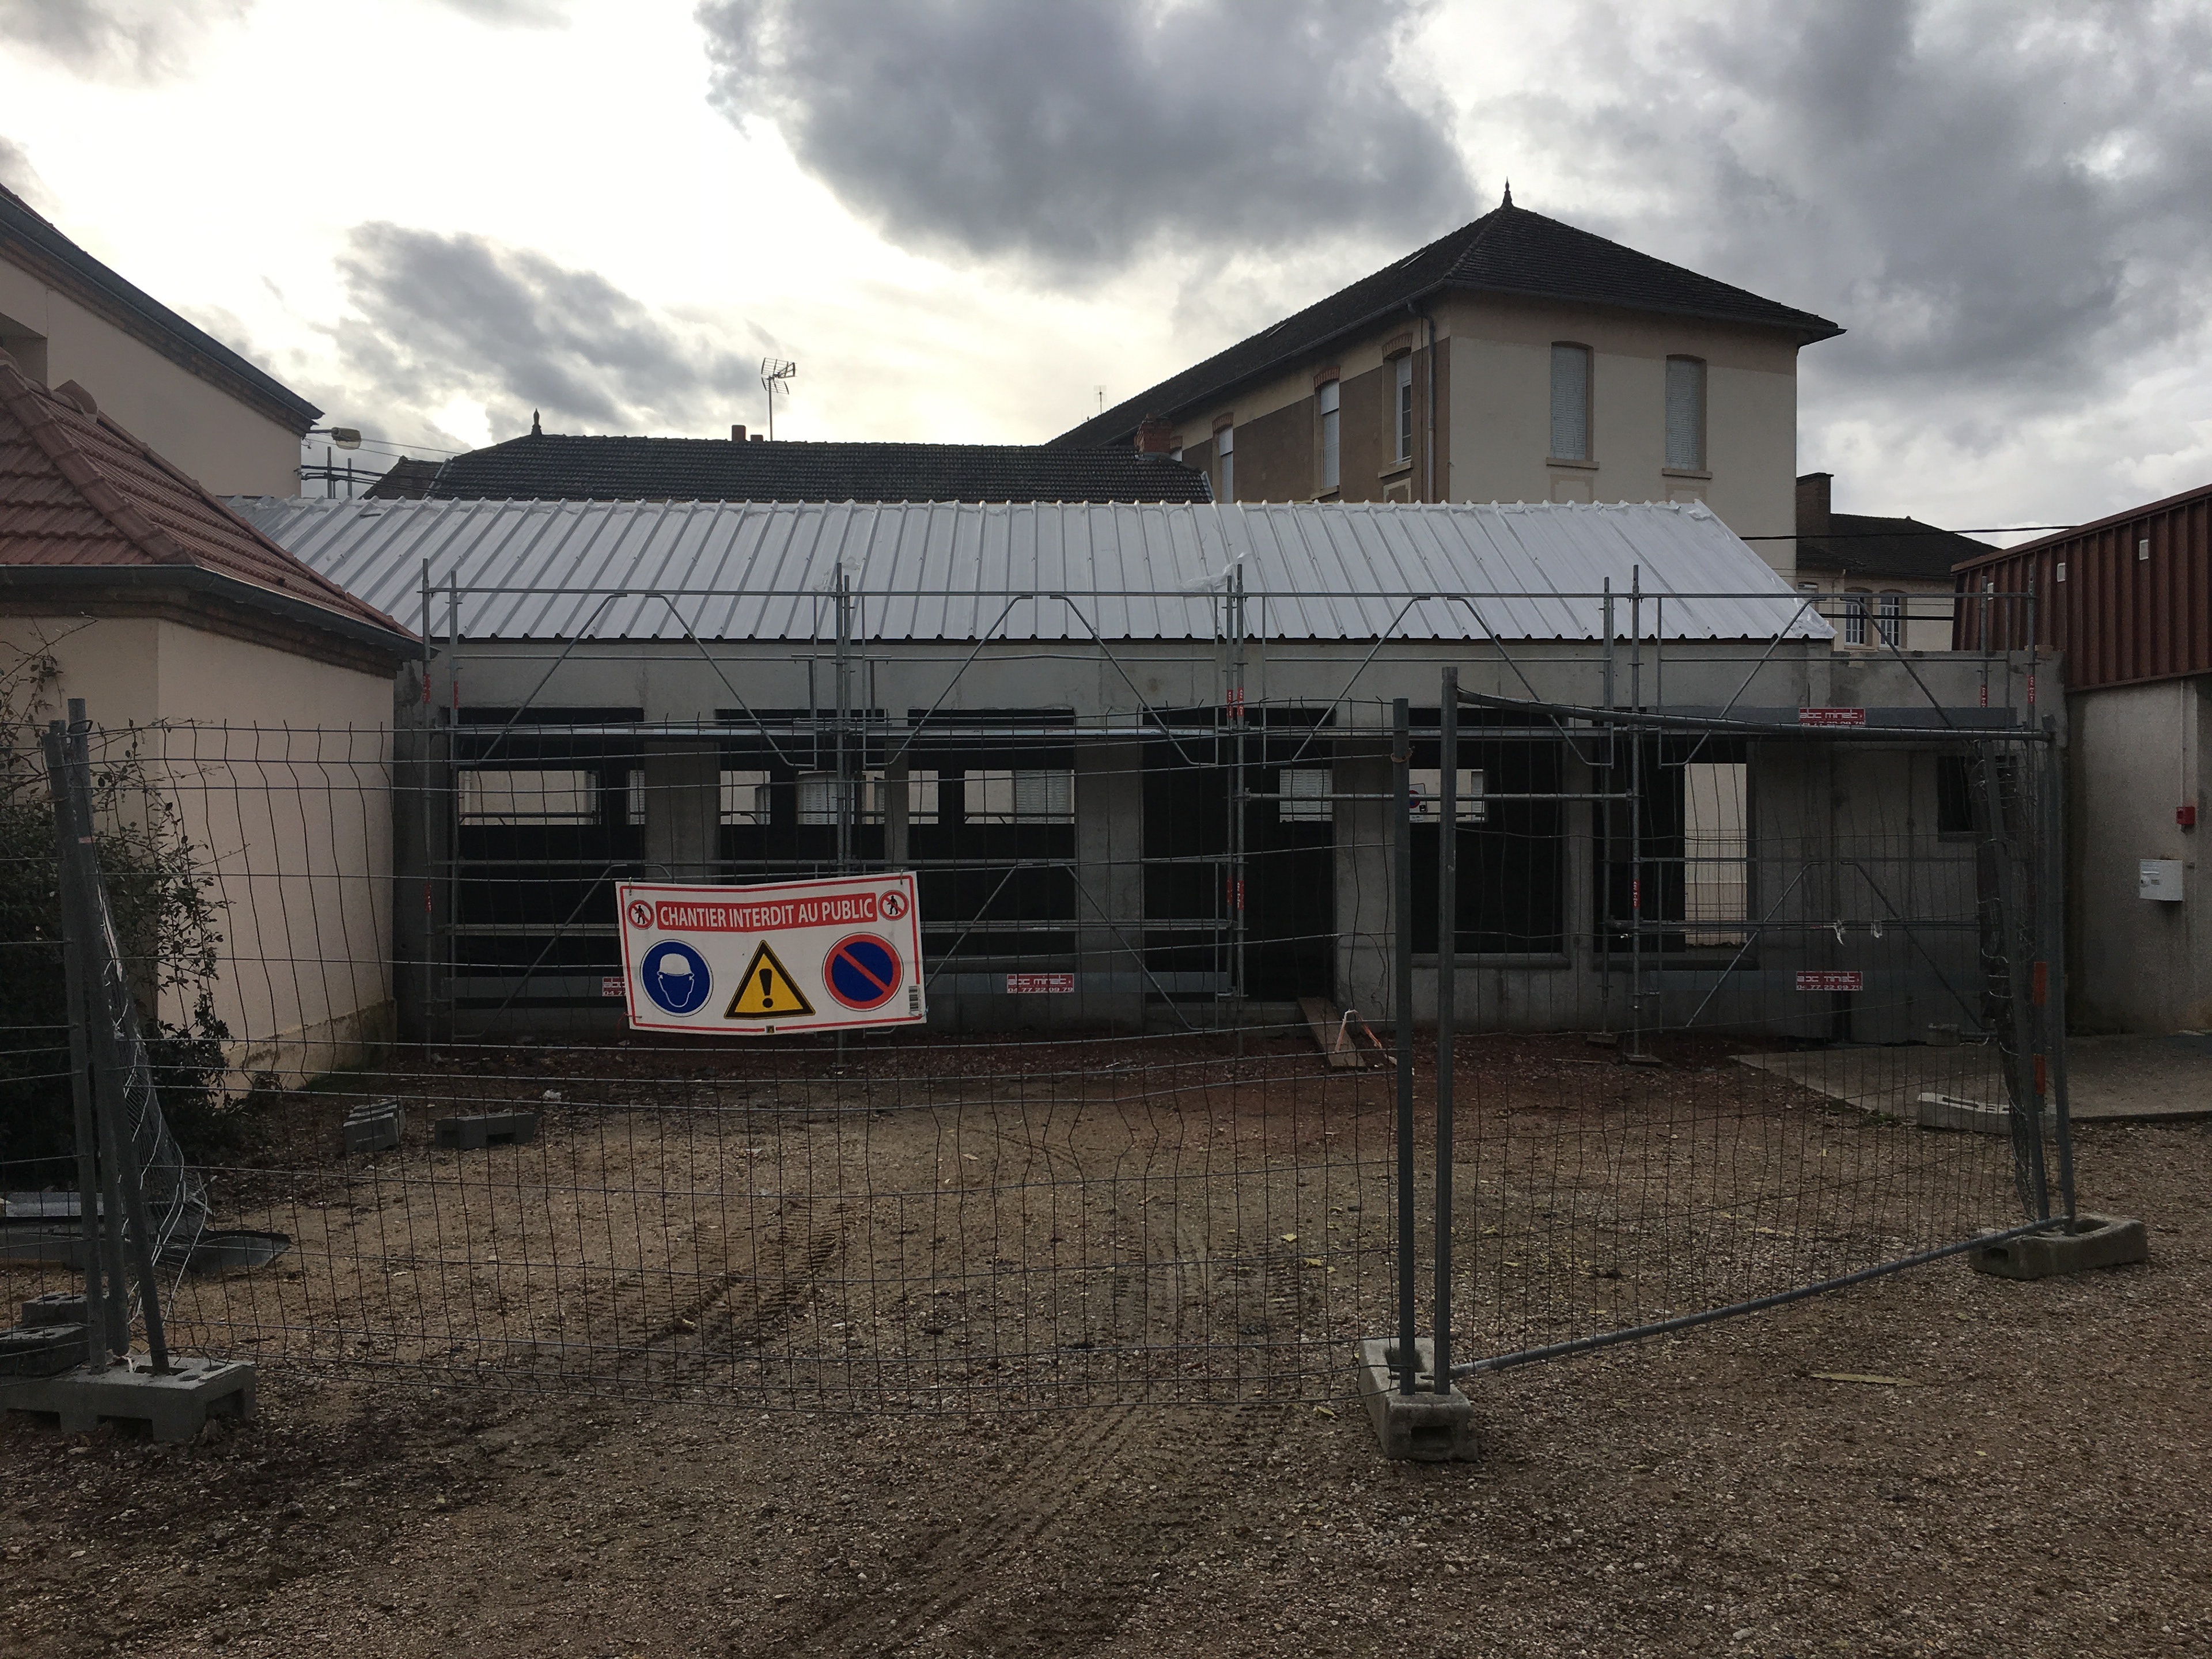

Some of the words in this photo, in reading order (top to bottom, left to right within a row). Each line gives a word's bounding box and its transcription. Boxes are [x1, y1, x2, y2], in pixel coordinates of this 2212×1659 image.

[1800, 709, 1822, 718] abc
[660, 906, 726, 927] CHANTIER
[729, 904, 794, 927] INTERDIT
[798, 903, 818, 923] AU
[822, 898, 873, 921] PUBLIC
